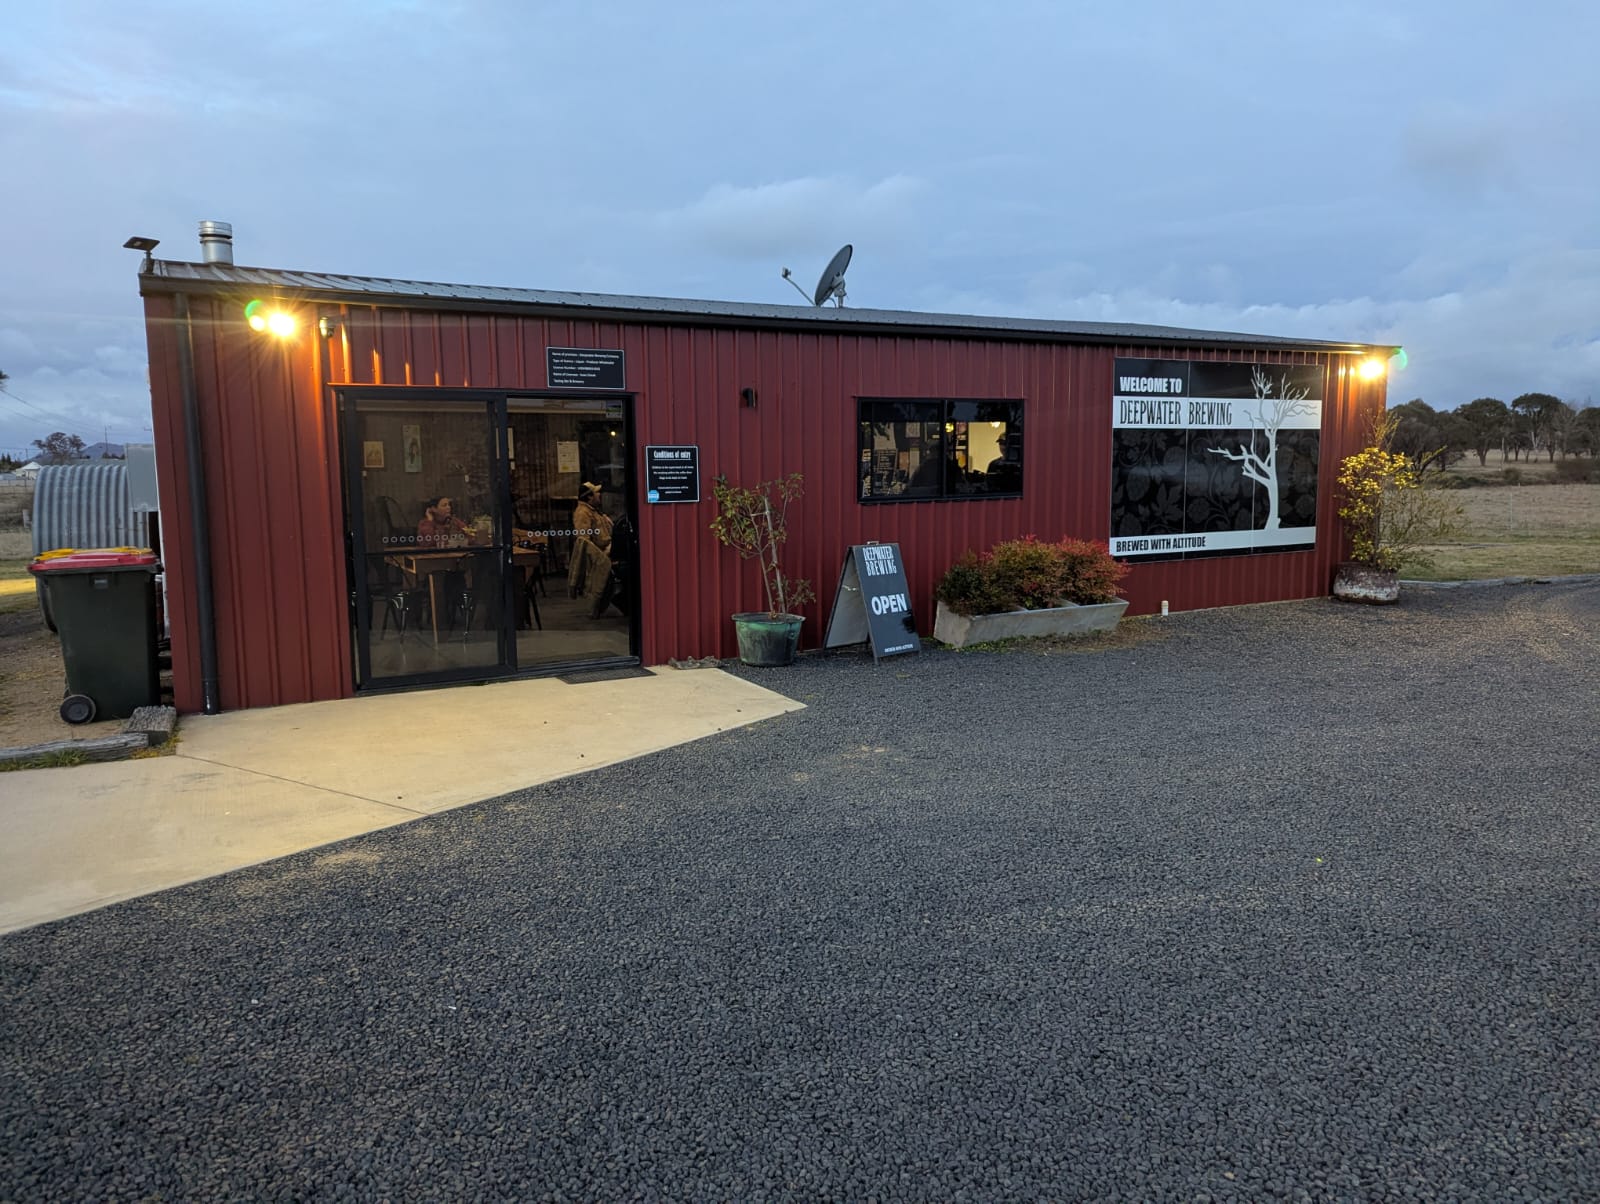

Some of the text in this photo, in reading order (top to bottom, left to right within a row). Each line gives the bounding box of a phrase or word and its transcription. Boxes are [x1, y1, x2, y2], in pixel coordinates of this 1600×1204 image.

[1120, 376, 1182, 393] WELCOME TO
[1120, 400, 1232, 425] DEEPWATER BREWING
[653, 450, 691, 460] Conditions of entry
[1116, 536, 1206, 552] BREWED WITH ALTITUDE
[862, 545, 894, 561] DEEPWATER
[865, 559, 897, 576] BREWING
[871, 593, 907, 615] OPEN
